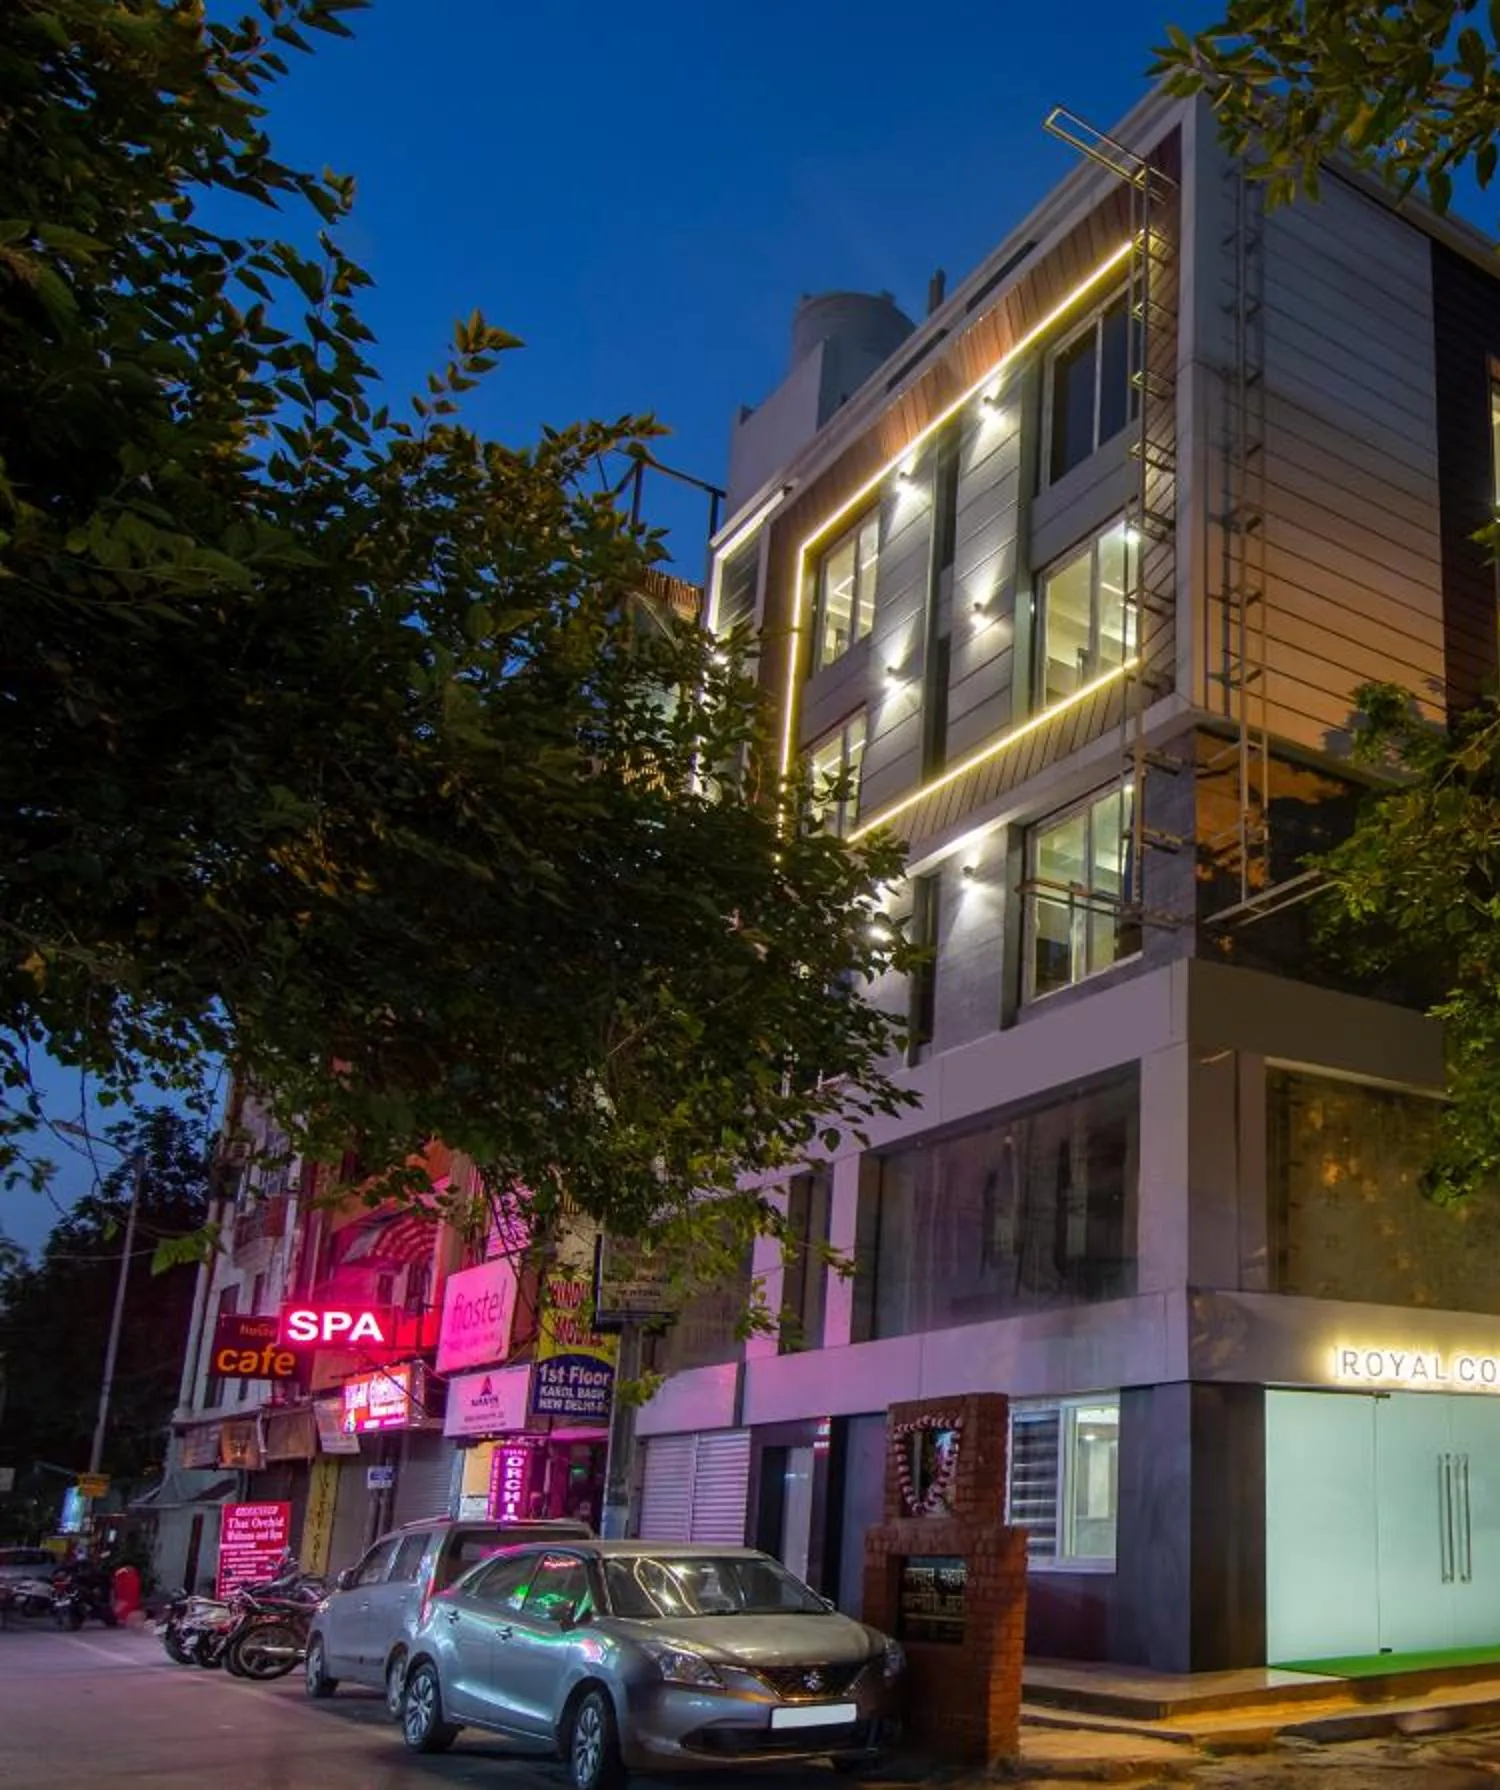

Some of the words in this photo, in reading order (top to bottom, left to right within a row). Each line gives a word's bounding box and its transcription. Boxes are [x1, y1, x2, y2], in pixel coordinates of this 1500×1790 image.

[287, 1310, 384, 1341] SPA
[216, 1344, 295, 1375] cafe
[1342, 1350, 1447, 1380] ROYAL
[539, 1363, 564, 1384] 1st
[570, 1365, 610, 1386] Floor
[538, 1398, 563, 1409] NEW
[540, 1386, 574, 1398] KAROL
[251, 1516, 285, 1529] Orchid
